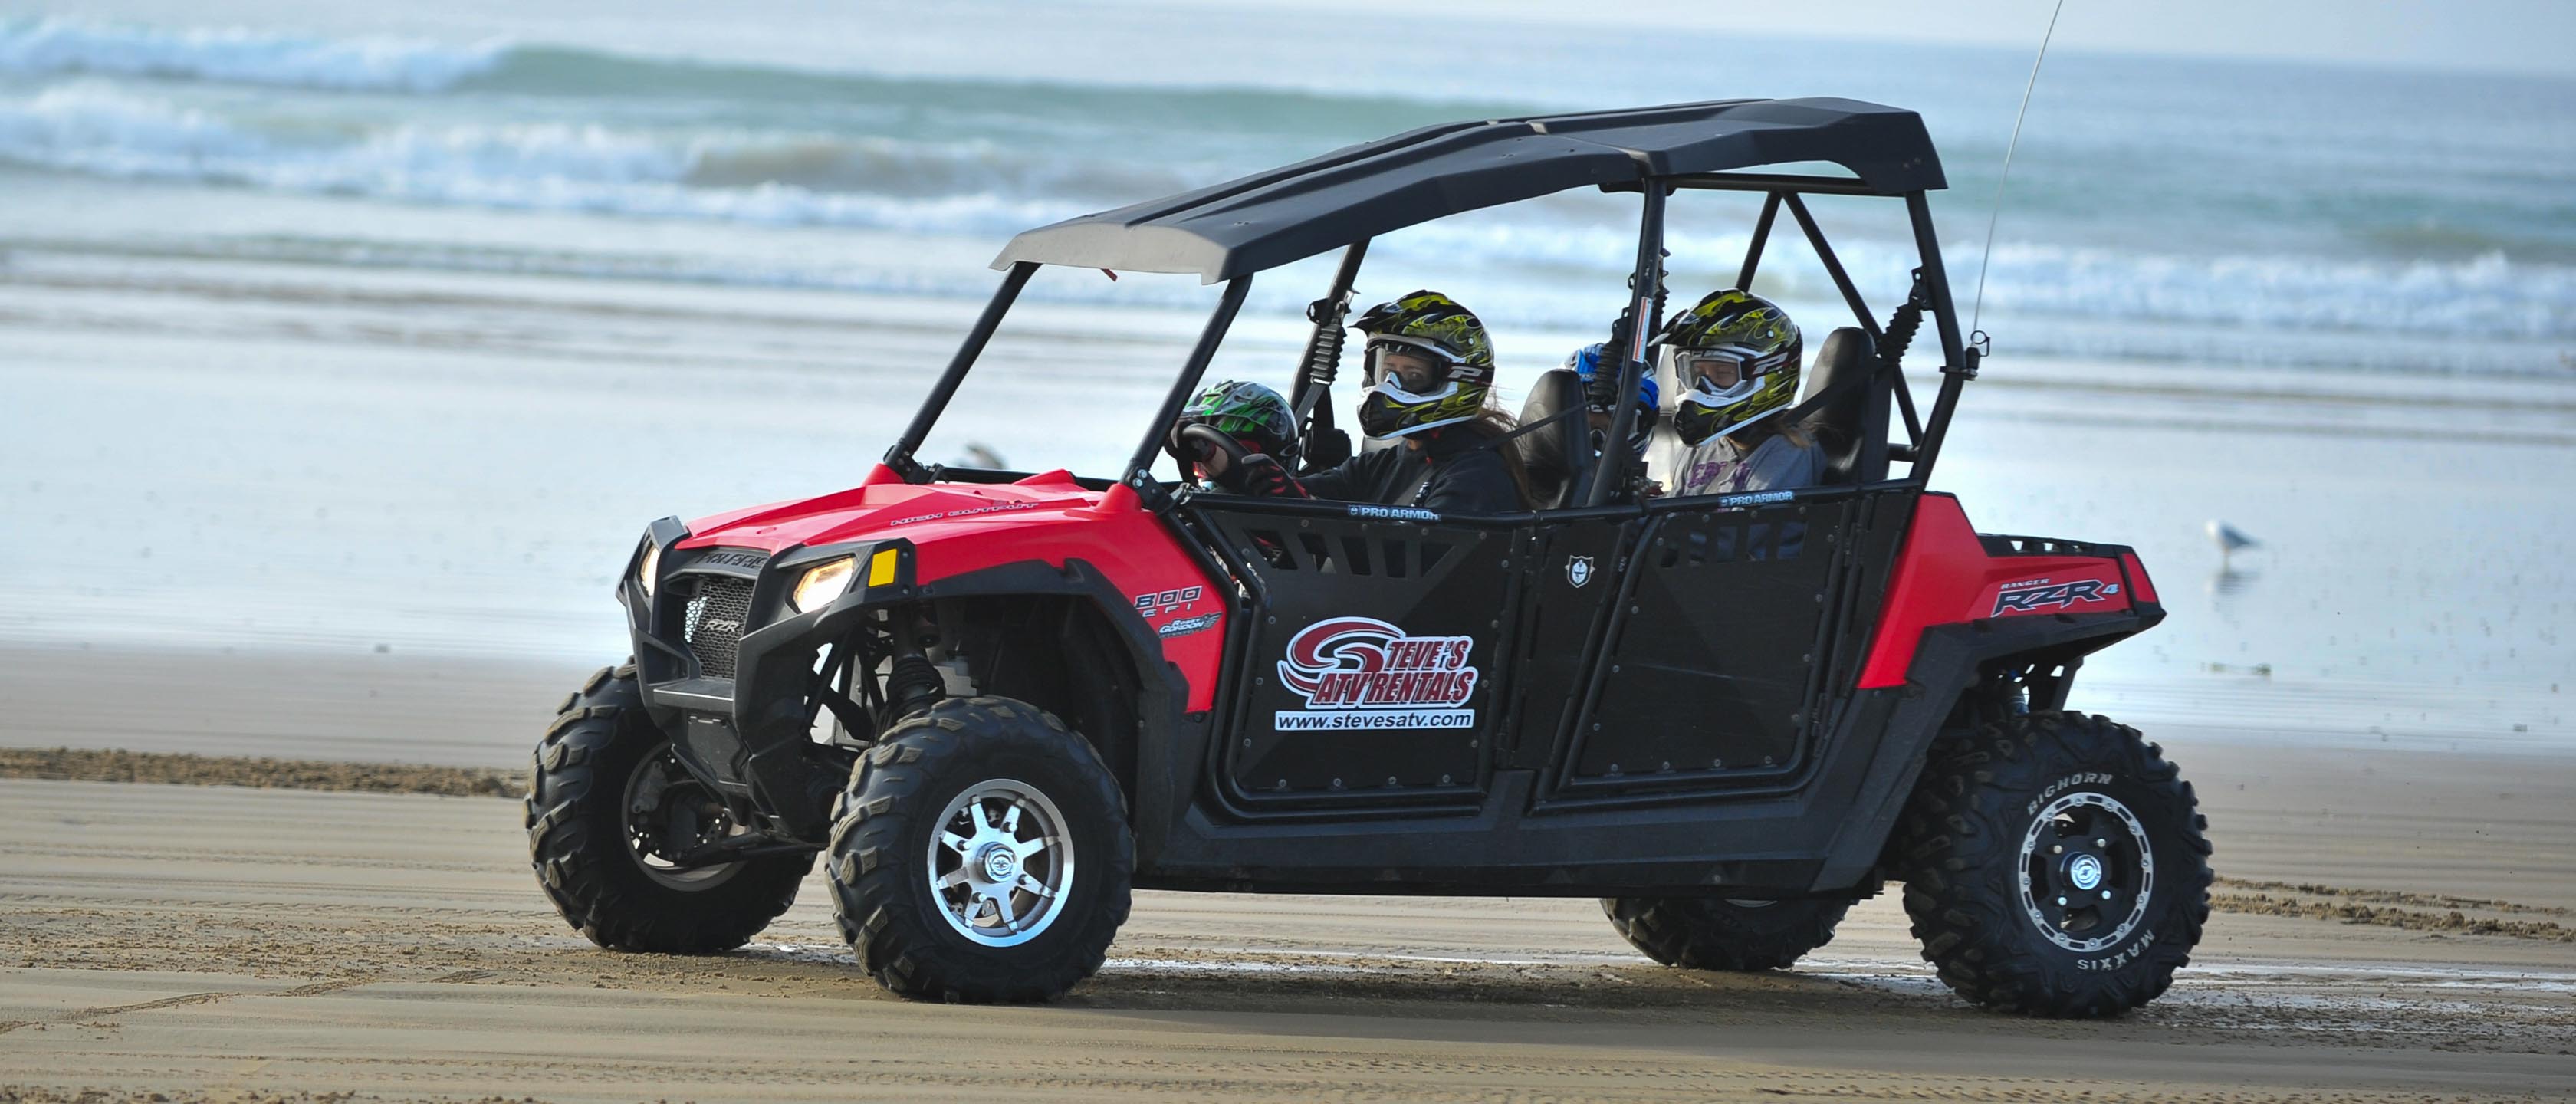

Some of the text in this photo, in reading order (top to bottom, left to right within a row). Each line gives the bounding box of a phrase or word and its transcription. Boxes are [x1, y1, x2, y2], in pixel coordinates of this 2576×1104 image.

[1730, 491, 1793, 506] PRO ARMOR
[890, 502, 1040, 526] HIGH OUTPUT
[1360, 507, 1388, 518] PRO
[2000, 578, 2049, 590] RANGER
[1134, 585, 1203, 610] 800
[1990, 579, 2119, 618] RZR 4
[703, 619, 740, 632] RZR
[1309, 671, 1475, 705] ATV RENTALS
[1278, 713, 1472, 728] www.stevesatv.com
[2027, 772, 2114, 816] BIGHORN
[2077, 928, 2157, 971] MAXXIS
